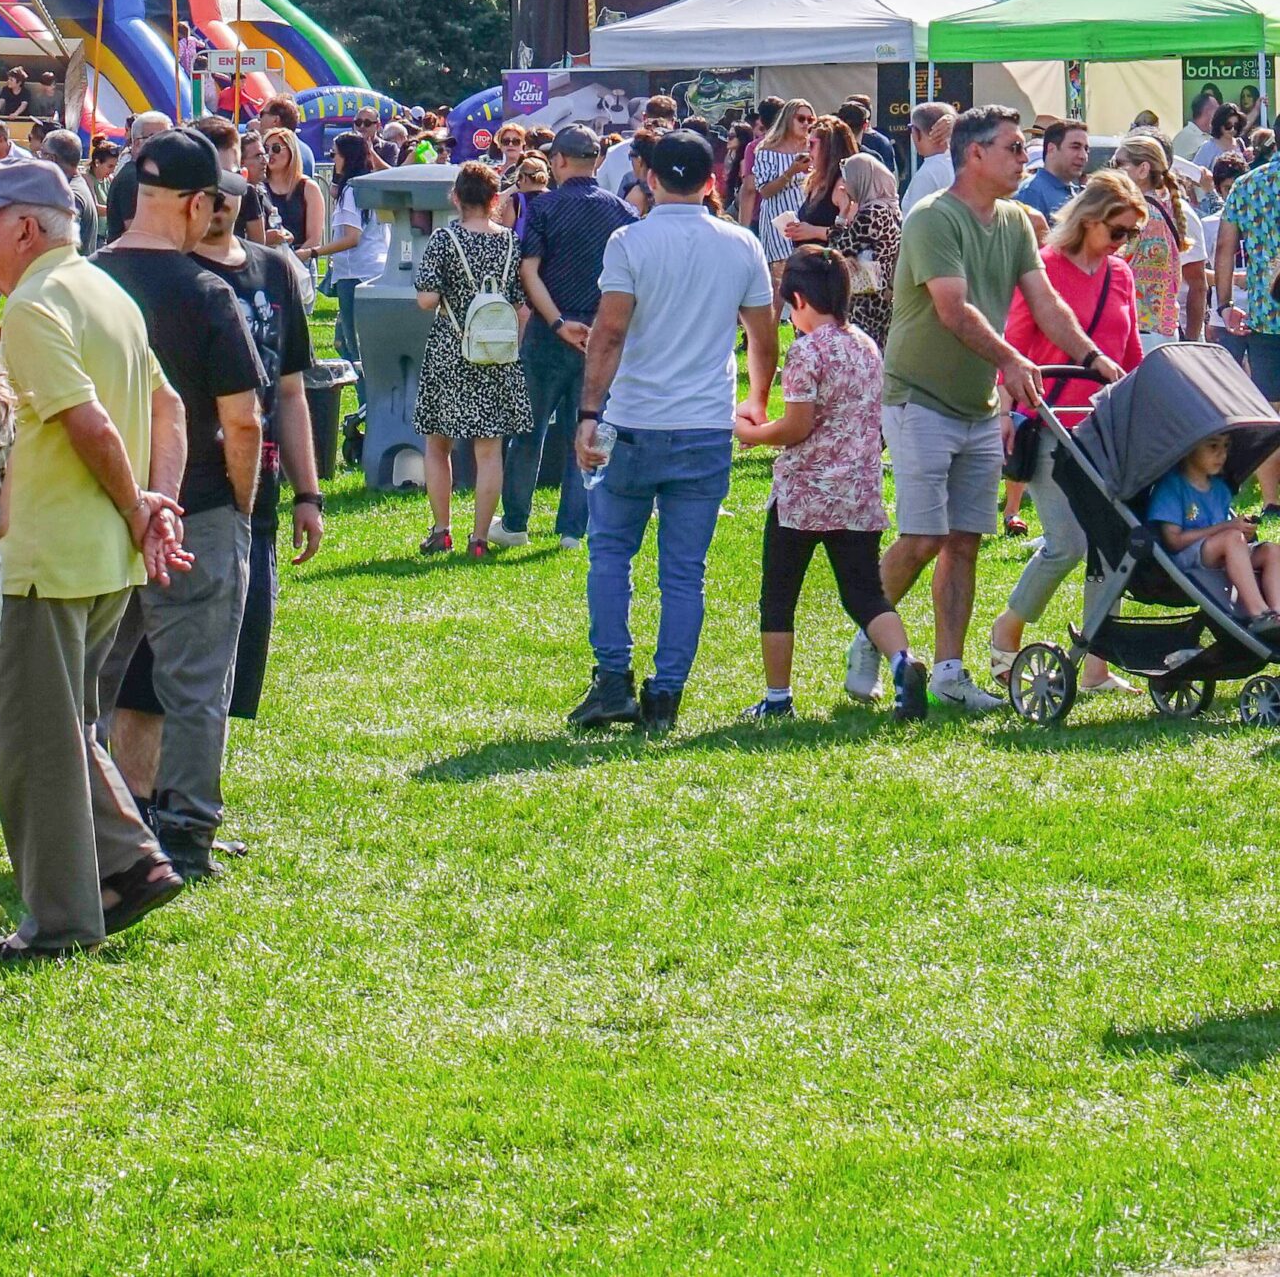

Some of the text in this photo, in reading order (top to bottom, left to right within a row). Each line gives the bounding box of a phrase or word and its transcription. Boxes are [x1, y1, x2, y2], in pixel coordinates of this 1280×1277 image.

[218, 57, 256, 66] ENER
[1243, 58, 1271, 68] saln
[519, 80, 535, 93] Dr
[512, 89, 543, 102] Scent
[475, 135, 491, 143] STOP
